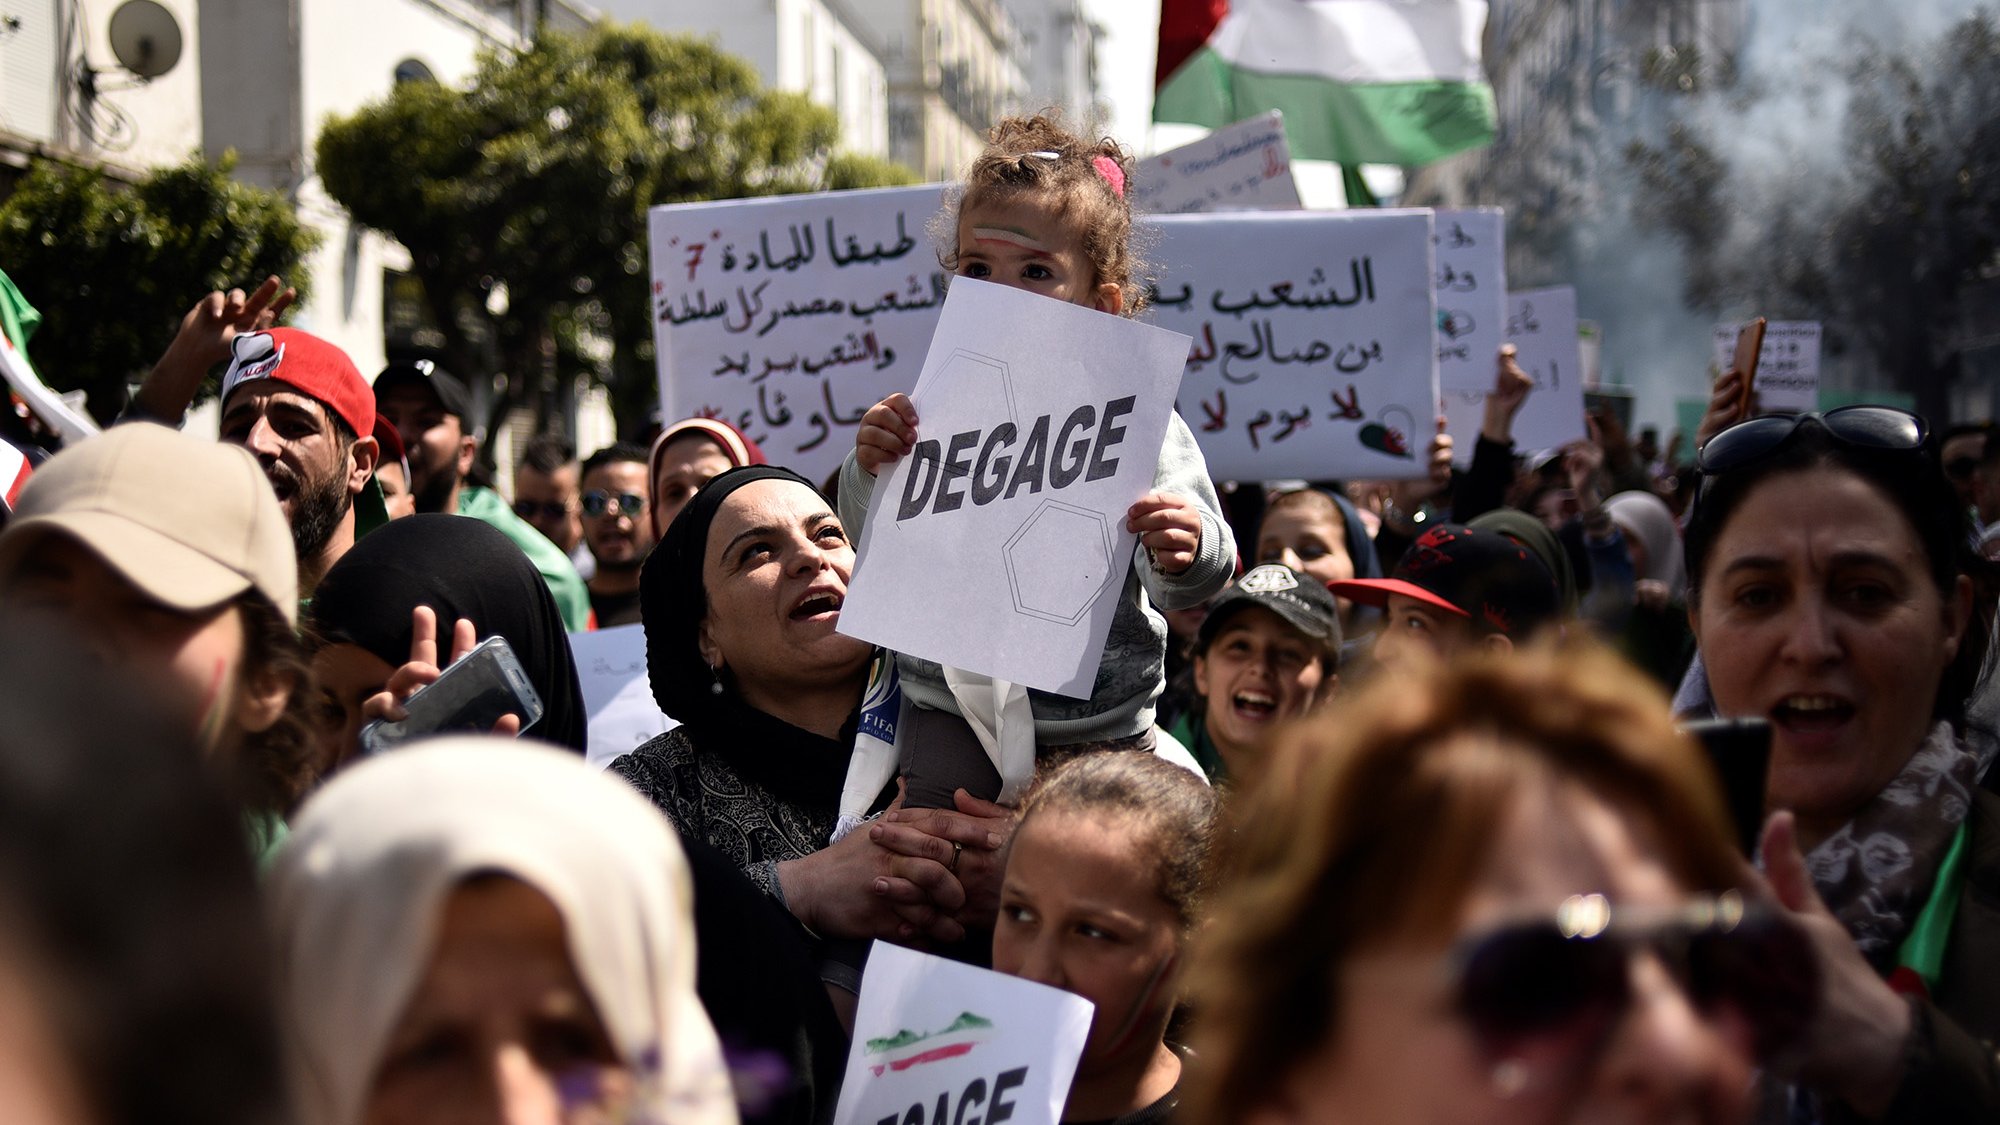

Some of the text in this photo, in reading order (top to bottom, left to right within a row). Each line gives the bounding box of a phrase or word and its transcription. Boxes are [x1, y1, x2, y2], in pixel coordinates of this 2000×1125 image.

[826, 211, 916, 268] طبقا
[1212, 255, 1376, 320] الشعب
[1219, 318, 1333, 384] صالح
[896, 394, 1137, 522] DEGAGE
[864, 712, 895, 736] FIFA
